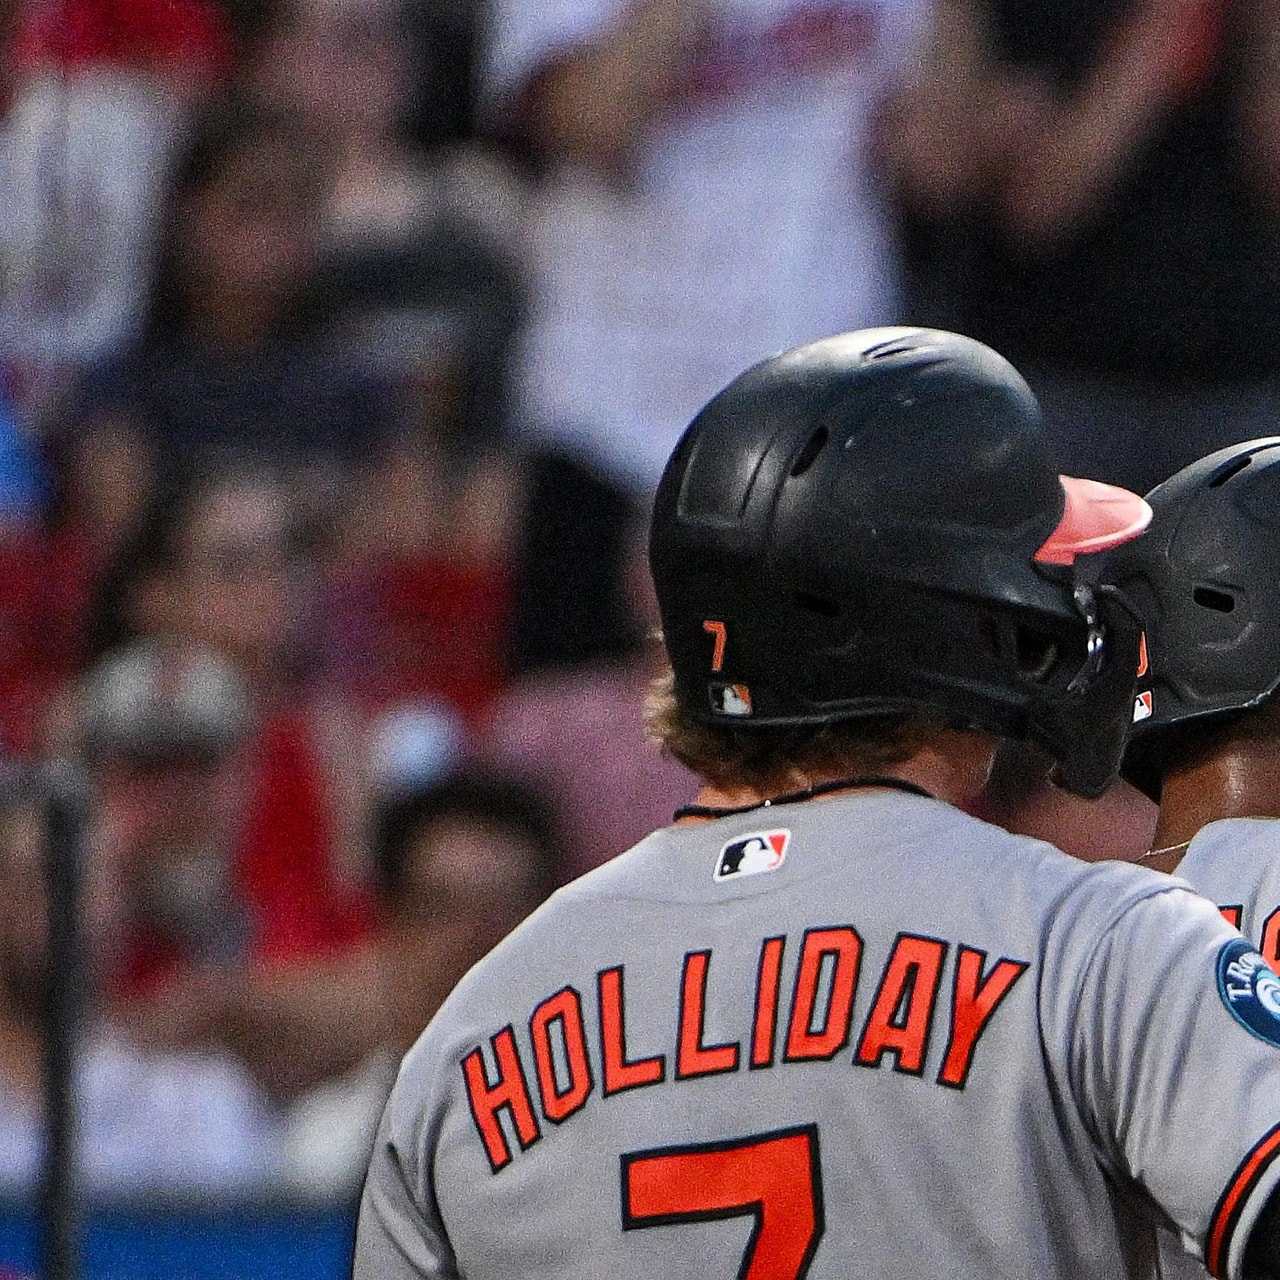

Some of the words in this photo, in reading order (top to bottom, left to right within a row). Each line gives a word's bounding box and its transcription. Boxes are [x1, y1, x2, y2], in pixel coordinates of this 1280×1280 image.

[702, 619, 728, 673] 7
[1226, 952, 1266, 1002] T.Ro
[460, 924, 1030, 1175] HOLLIDAY
